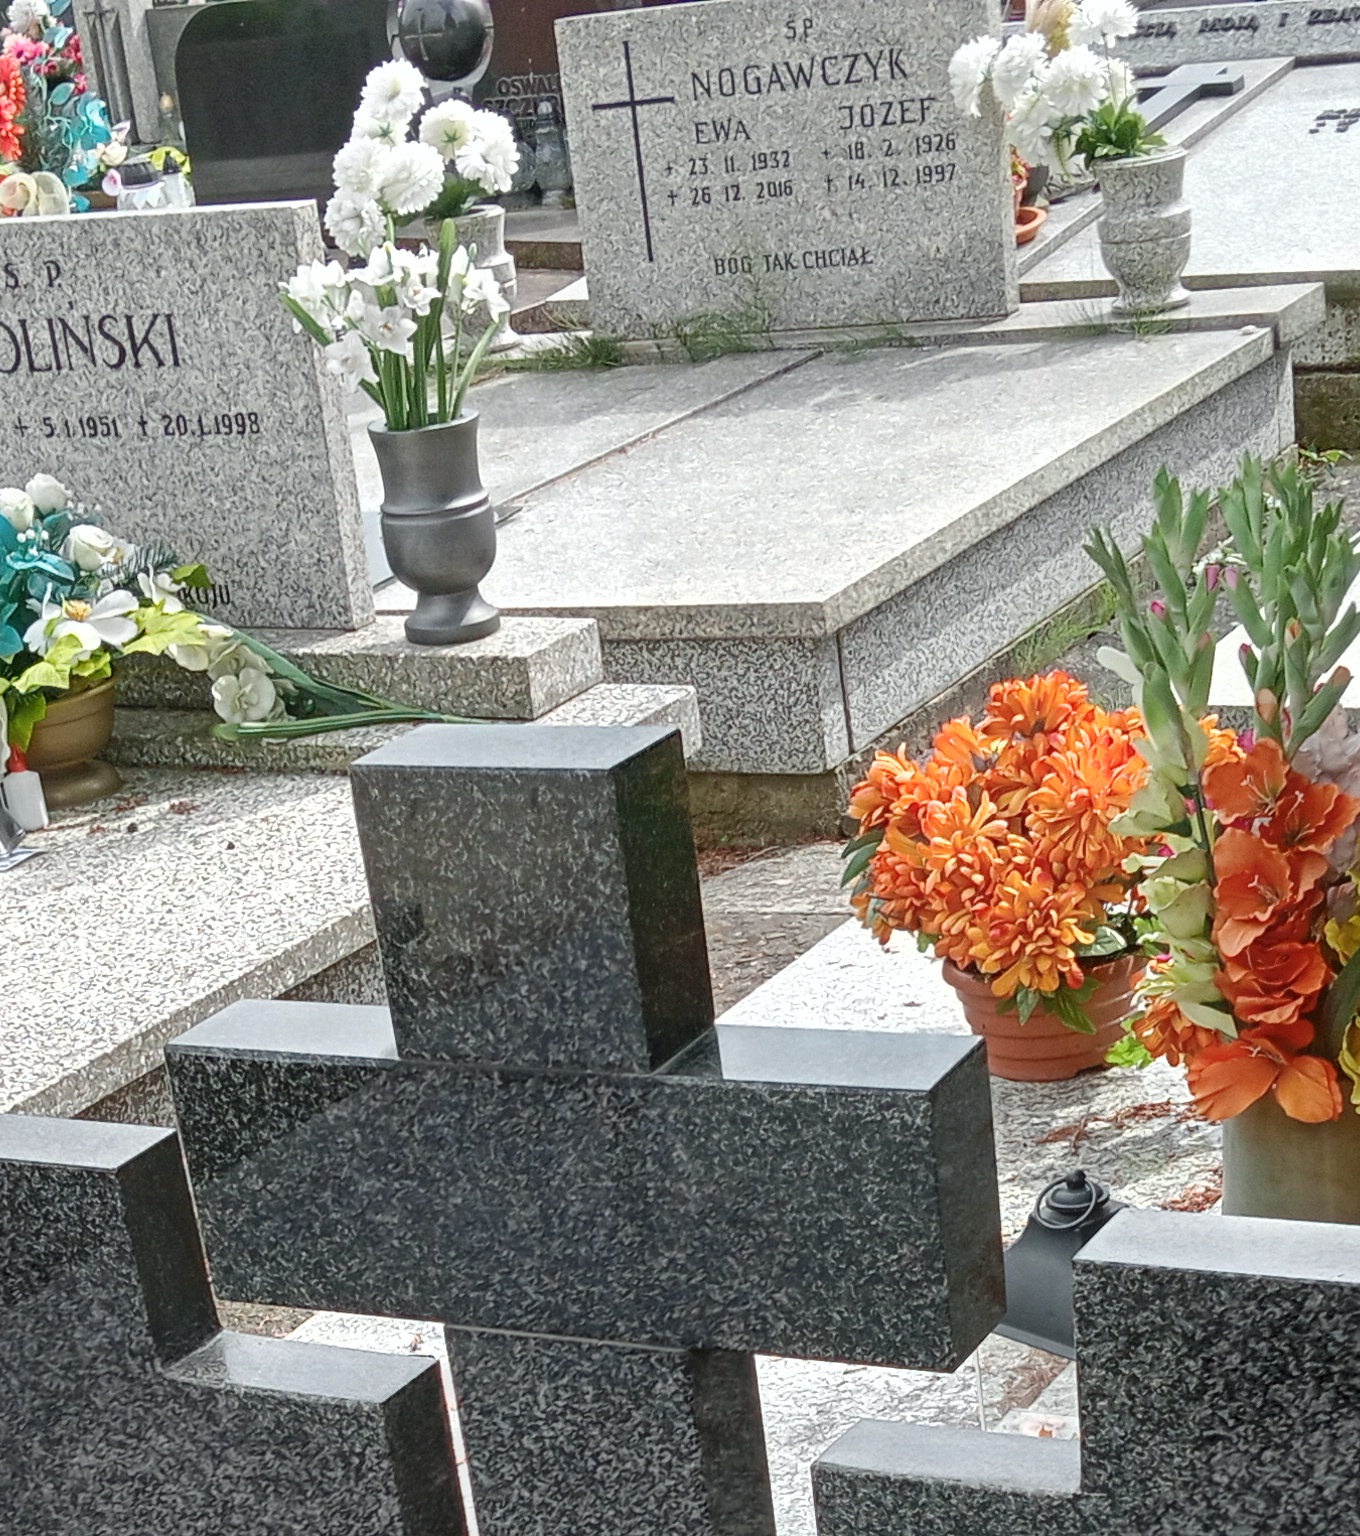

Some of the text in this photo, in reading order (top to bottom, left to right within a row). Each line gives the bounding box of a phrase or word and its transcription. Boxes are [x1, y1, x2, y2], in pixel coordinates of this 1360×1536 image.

[691, 48, 908, 101] NOGAWCZYK
[694, 117, 752, 144] EWA
[916, 132, 956, 157] 1926
[752, 150, 790, 171] 1932
[917, 163, 956, 184] 1997
[756, 180, 793, 199] 2016
[763, 252, 798, 273] TAK
[803, 247, 873, 270] CHCIAŁ
